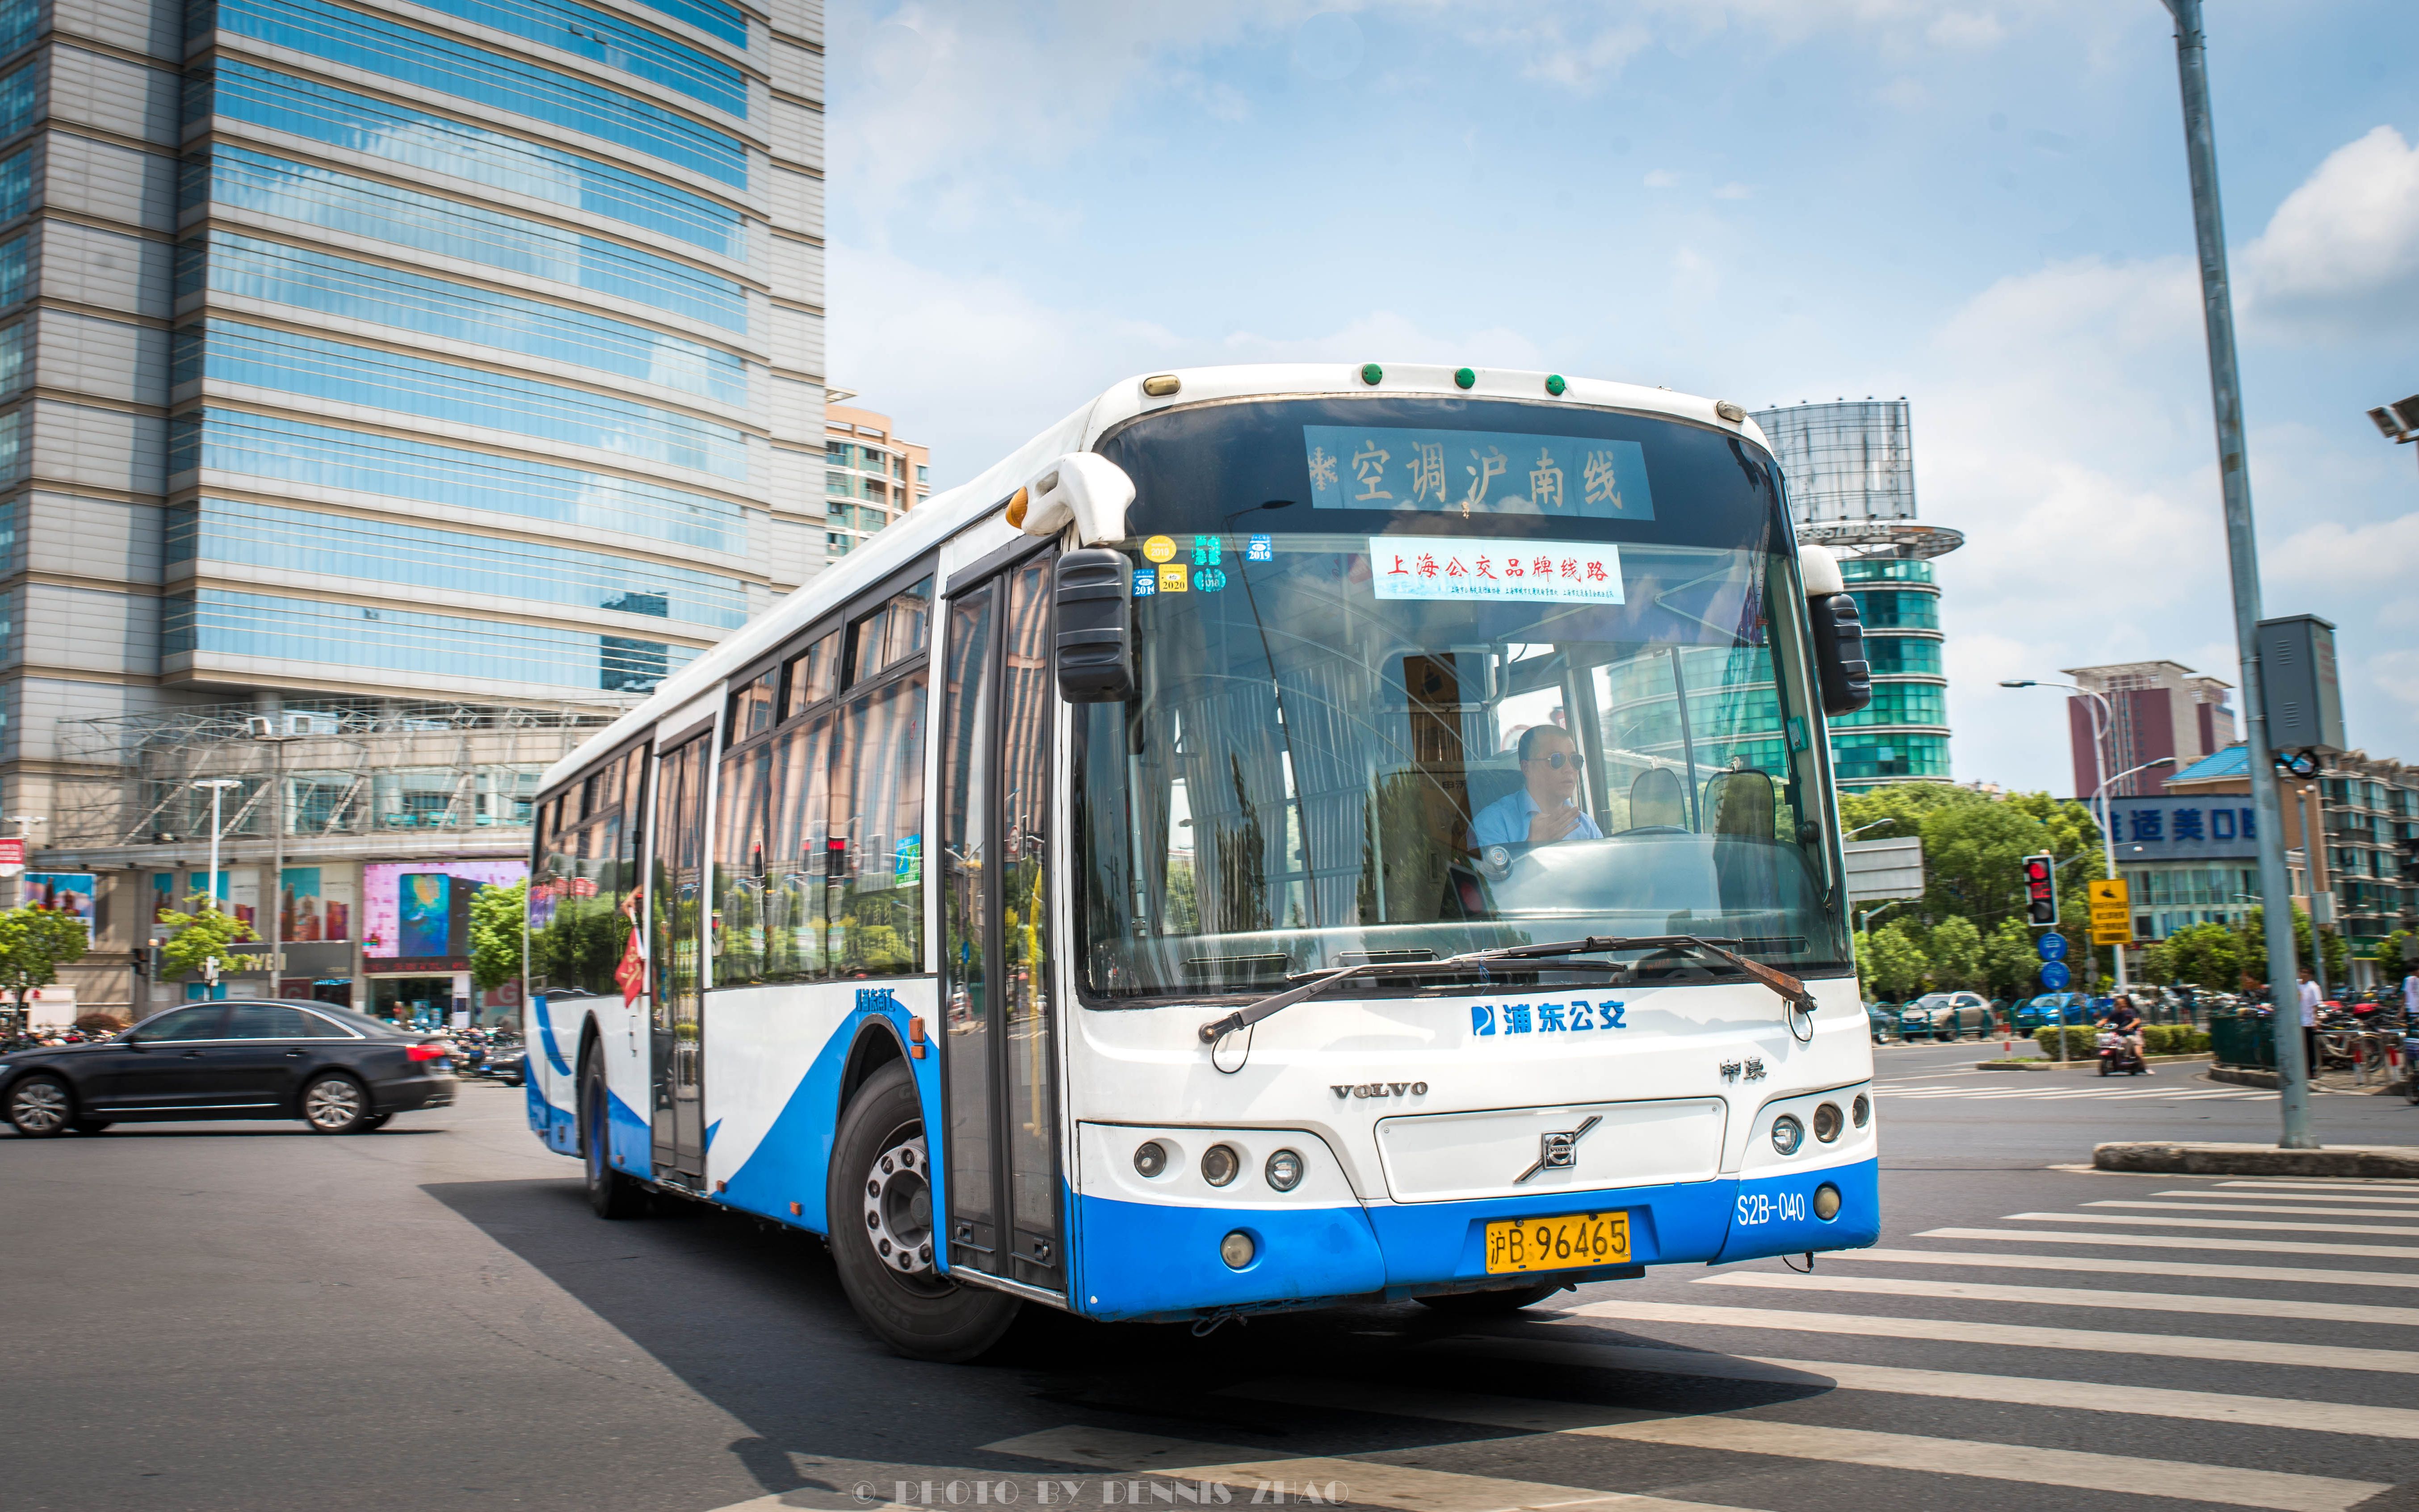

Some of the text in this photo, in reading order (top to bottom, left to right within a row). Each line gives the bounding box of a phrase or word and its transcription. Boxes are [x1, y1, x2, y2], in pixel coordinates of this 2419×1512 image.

[1352, 440, 1623, 510] 空调沪南线
[1151, 548, 1169, 556] 2019
[1248, 550, 1270, 559] 2019
[1387, 554, 1609, 582] 上海公交品牌线路
[1163, 581, 1185, 589] 2020
[862, 988, 895, 1012] 浦东南汇
[1503, 1000, 1626, 1034] 浦东公交
[1330, 1081, 1428, 1099] VOLVO
[1737, 1192, 1805, 1226] S2B-040
